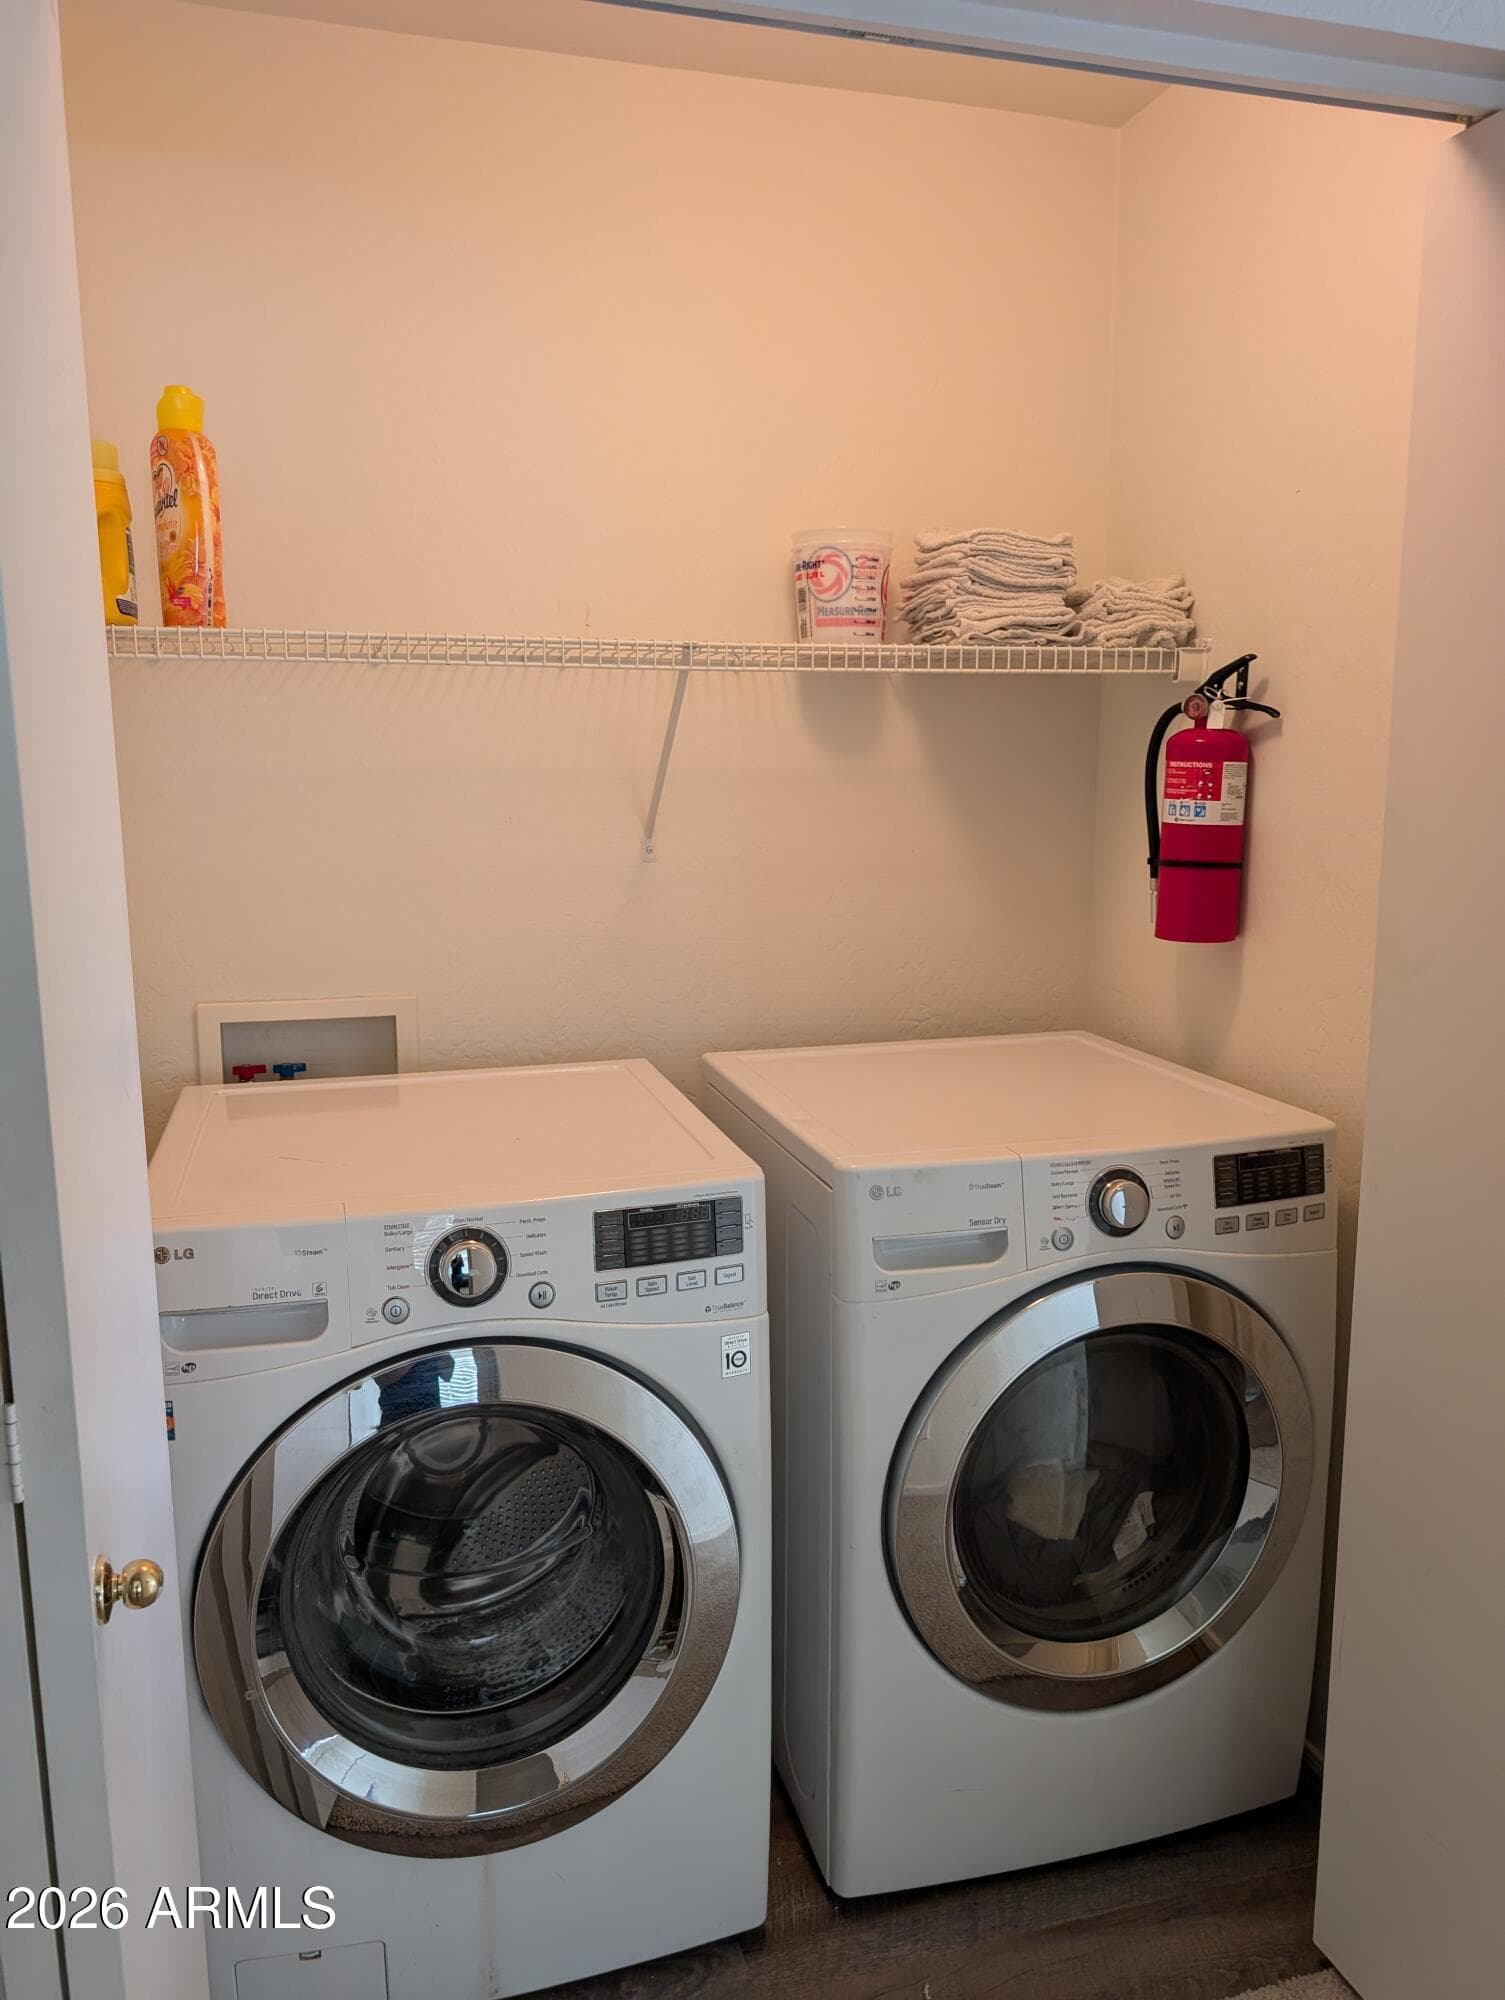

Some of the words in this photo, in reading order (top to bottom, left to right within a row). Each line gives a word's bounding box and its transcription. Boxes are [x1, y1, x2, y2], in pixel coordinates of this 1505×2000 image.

[886, 1185, 902, 1197] LG
[969, 1218, 993, 1227] Sensor
[994, 1216, 1007, 1225] Dry
[174, 1247, 195, 1261] LG
[252, 1290, 278, 1300] Direct
[725, 1350, 747, 1370] 10
